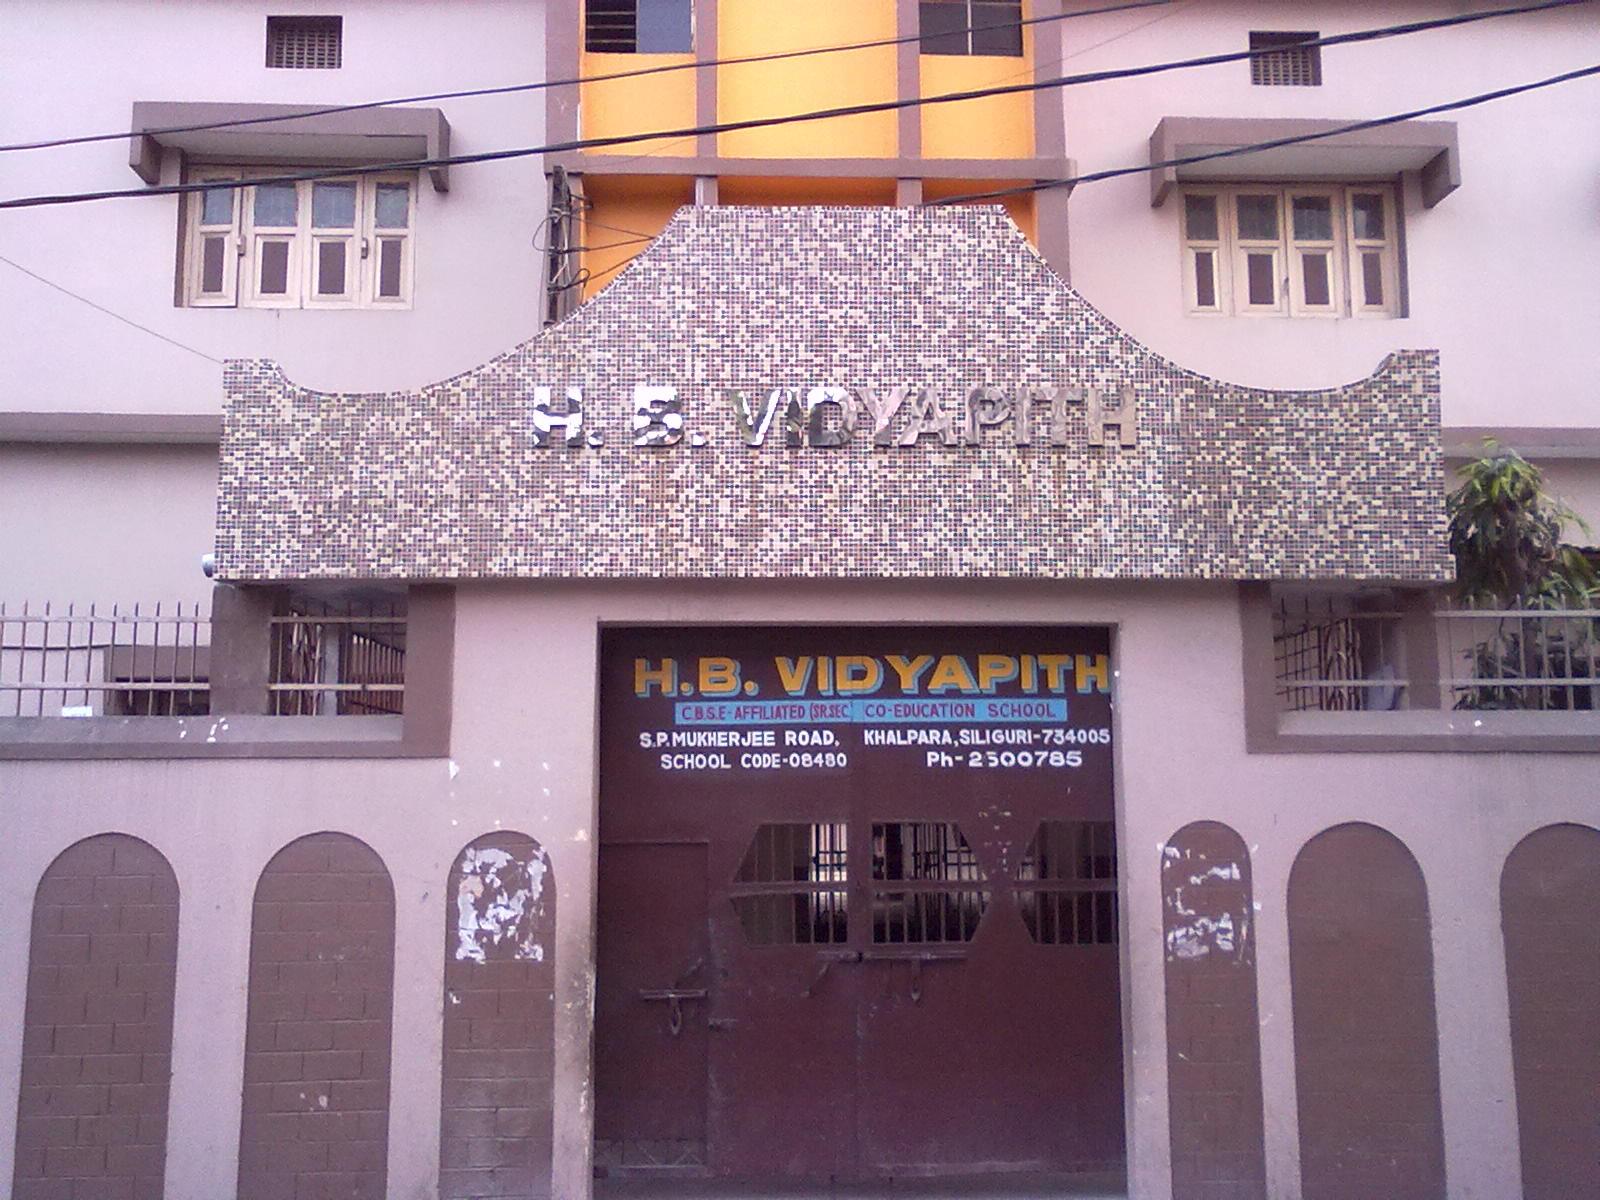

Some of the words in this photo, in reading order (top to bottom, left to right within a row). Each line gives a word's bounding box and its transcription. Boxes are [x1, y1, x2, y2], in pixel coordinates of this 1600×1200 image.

[726, 387, 1136, 448] VIDYAPITH
[775, 654, 1110, 696] VIDYAPITH
[865, 703, 975, 719] CO-EDUCATION
[988, 703, 1056, 718] SCHOOL
[661, 754, 731, 770] SCHOOL
[741, 753, 847, 768] CODE-08480
